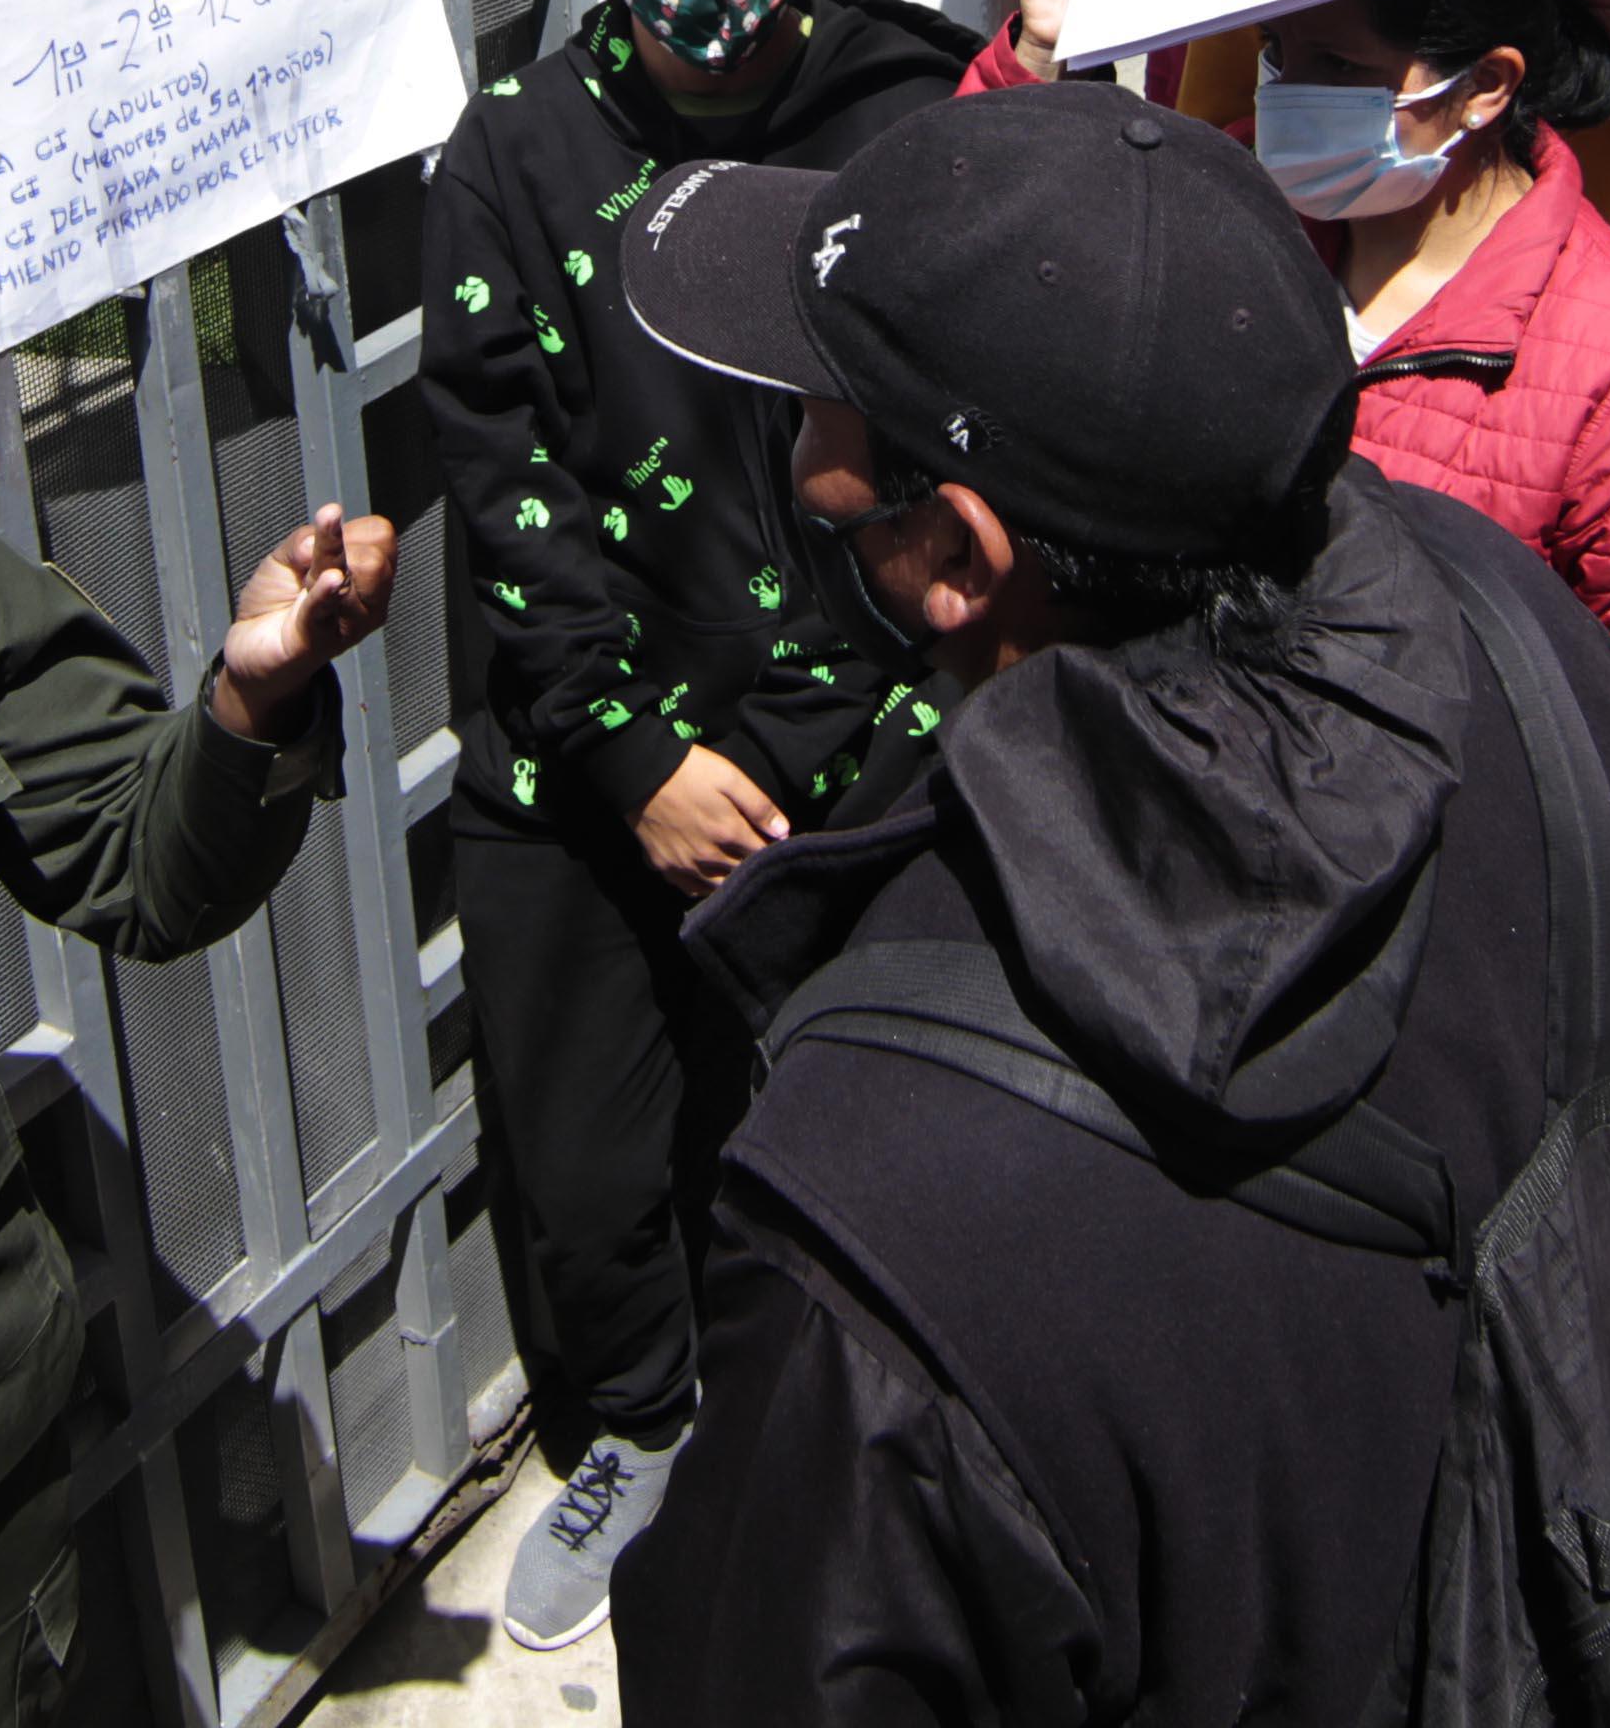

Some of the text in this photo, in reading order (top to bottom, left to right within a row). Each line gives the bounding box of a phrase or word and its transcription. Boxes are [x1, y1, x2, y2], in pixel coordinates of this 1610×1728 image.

[10, 174, 41, 205] CI
[175, 105, 202, 133] de
[34, 128, 68, 162] CI
[87, 61, 210, 140] (ADULTOS)
[5, 219, 36, 251] CI
[49, 194, 99, 236] DEL
[95, 183, 191, 249] FIRMADO
[197, 160, 240, 198] POR
[239, 142, 265, 173] EL
[266, 106, 344, 154] TUTOR
[646, 169, 714, 234] ANGELES
